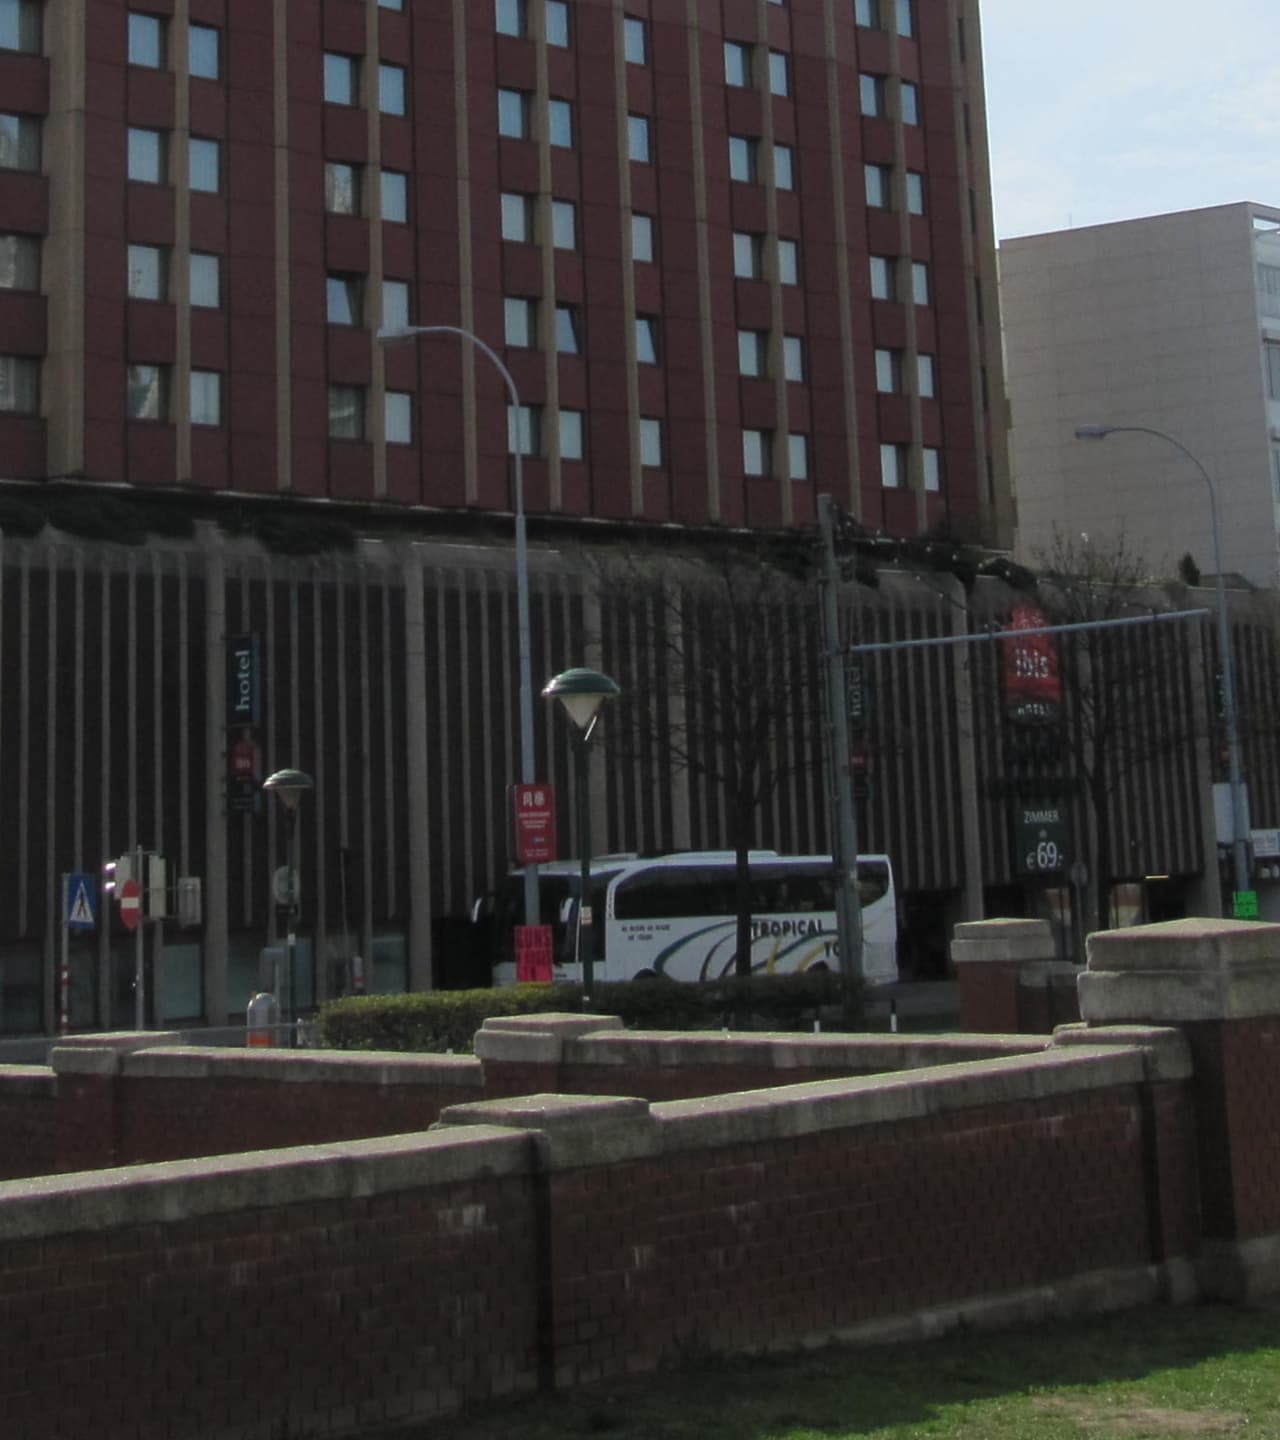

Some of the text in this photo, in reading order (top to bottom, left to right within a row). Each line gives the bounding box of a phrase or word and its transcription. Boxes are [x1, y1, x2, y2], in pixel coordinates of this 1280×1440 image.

[1016, 649, 1050, 679] ibis
[235, 650, 251, 711] hotel
[1024, 810, 1059, 824] ZIMMER
[752, 919, 824, 938] TROPICAL
